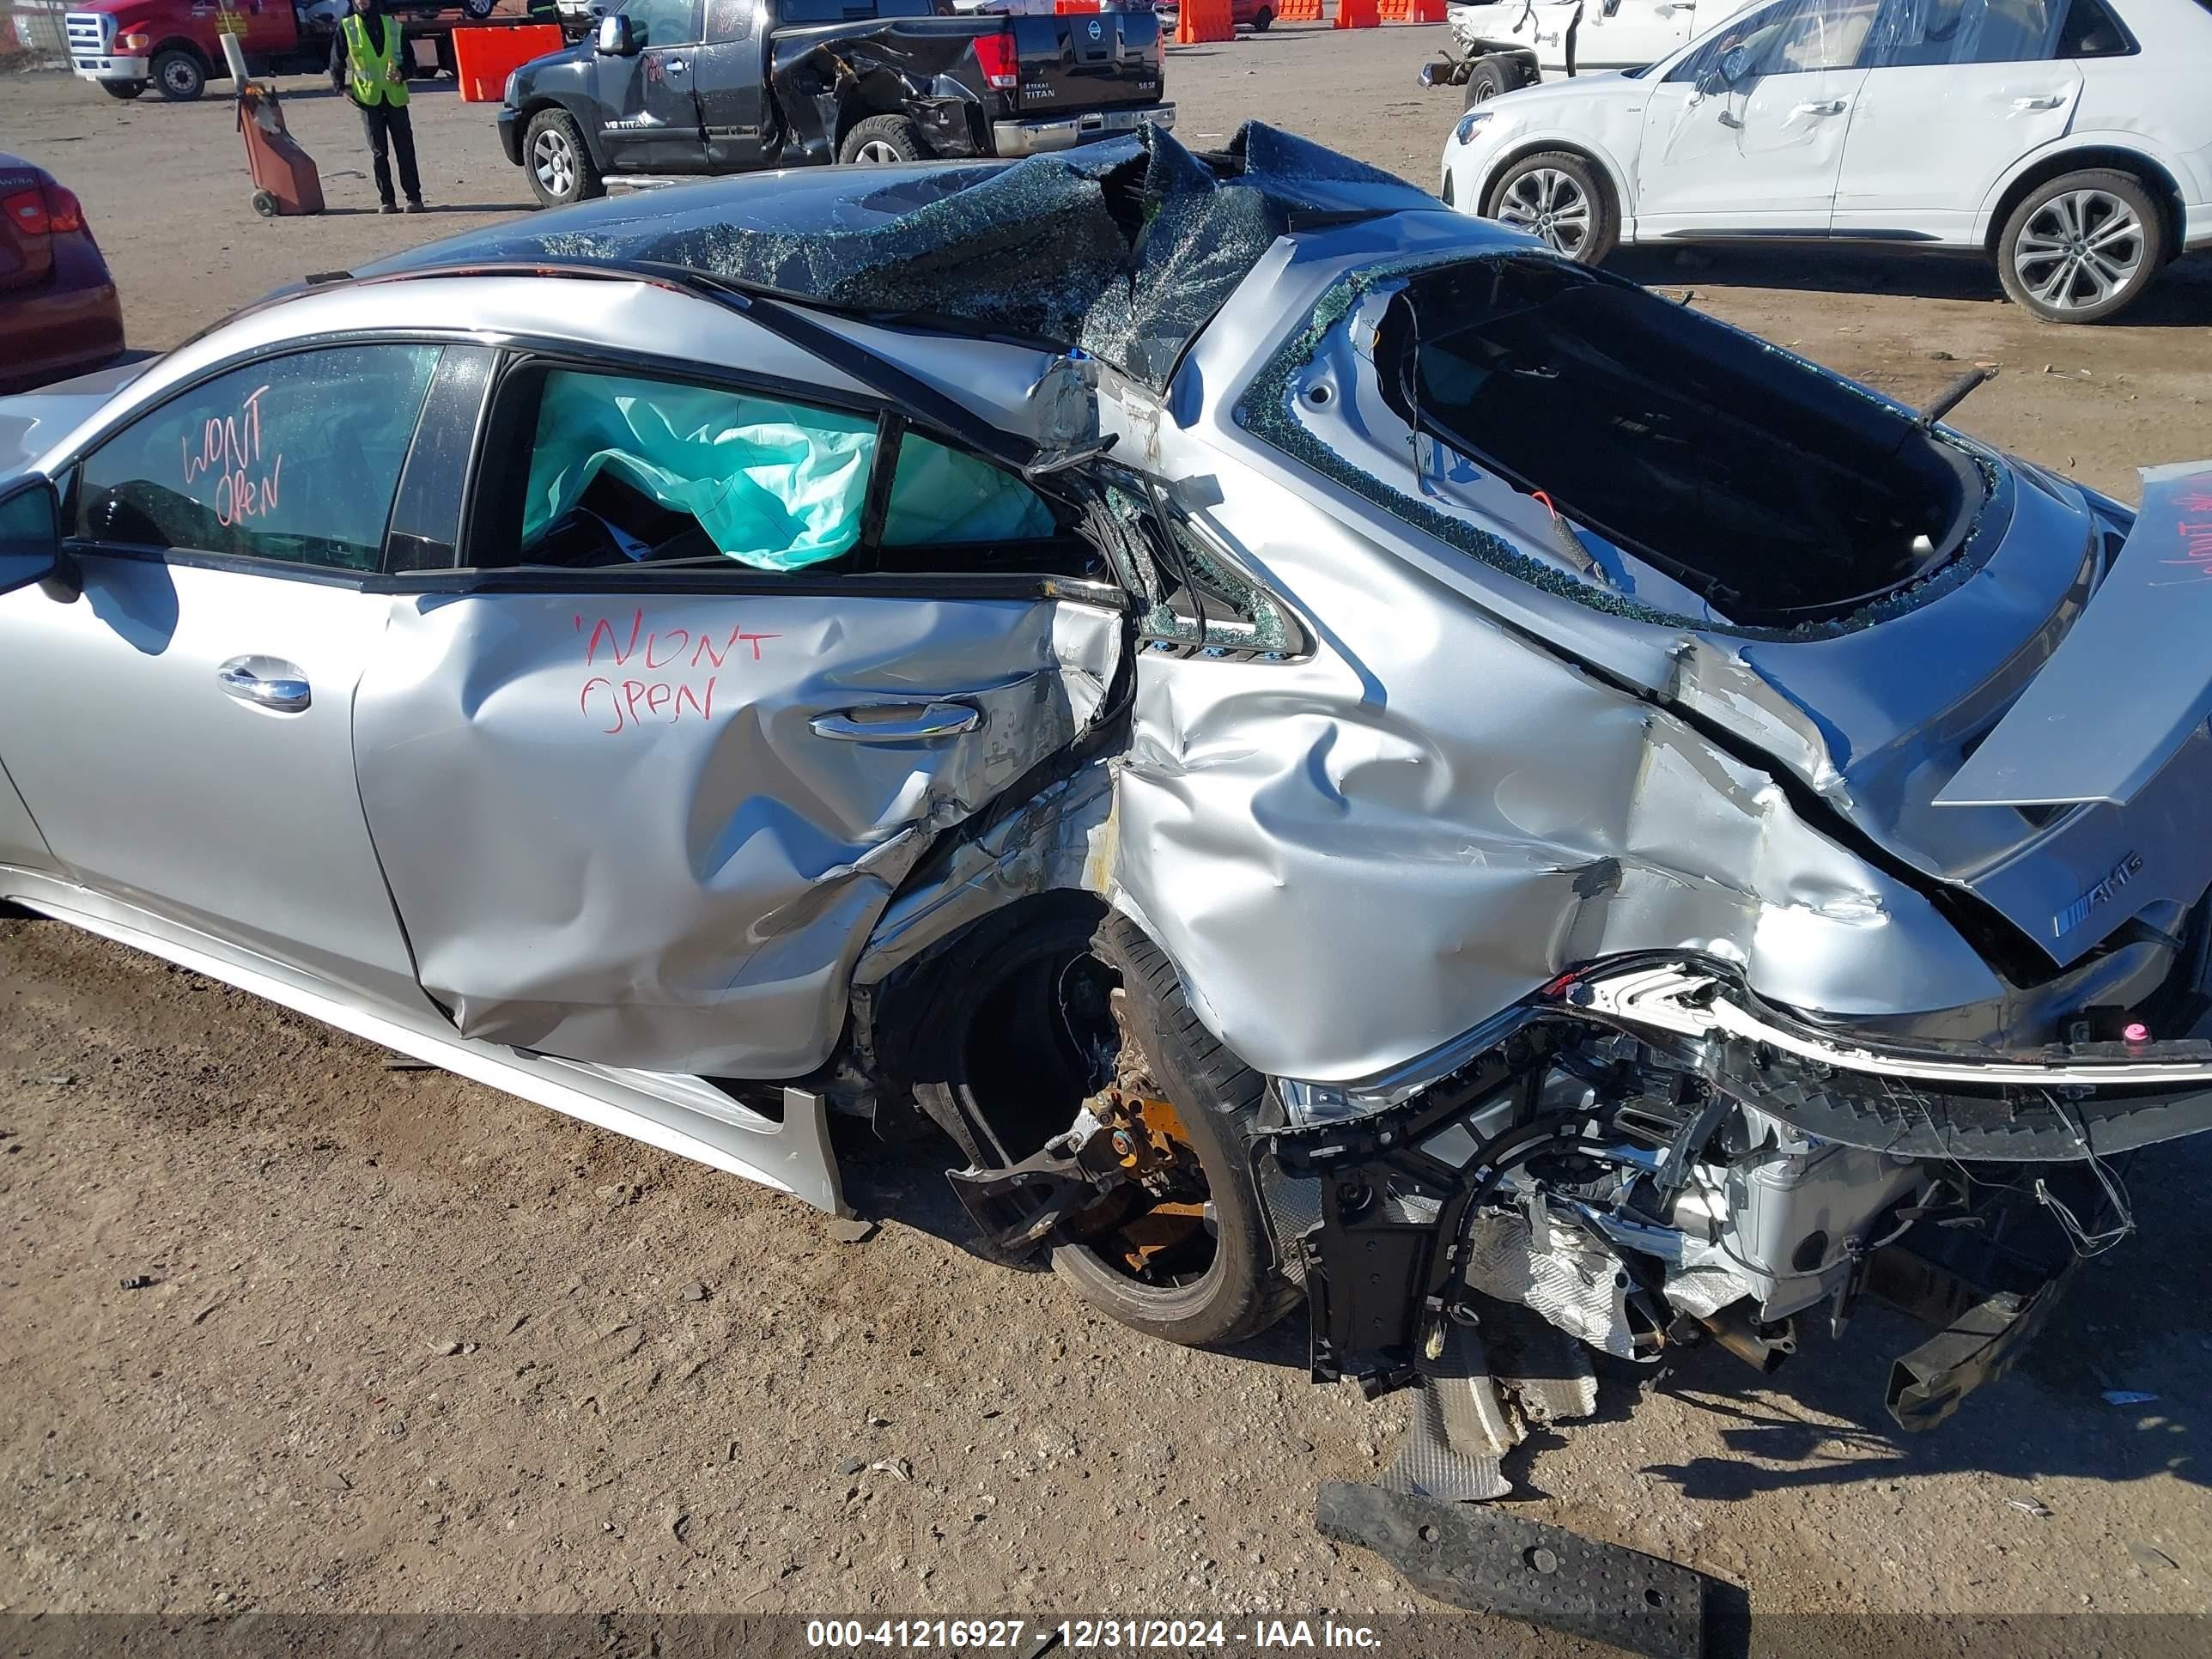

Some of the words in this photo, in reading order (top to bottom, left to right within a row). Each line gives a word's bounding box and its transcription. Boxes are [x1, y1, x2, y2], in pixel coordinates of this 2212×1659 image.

[1024, 88, 1055, 100] TITAN
[619, 120, 649, 129] TITAN
[182, 385, 270, 484] WONT
